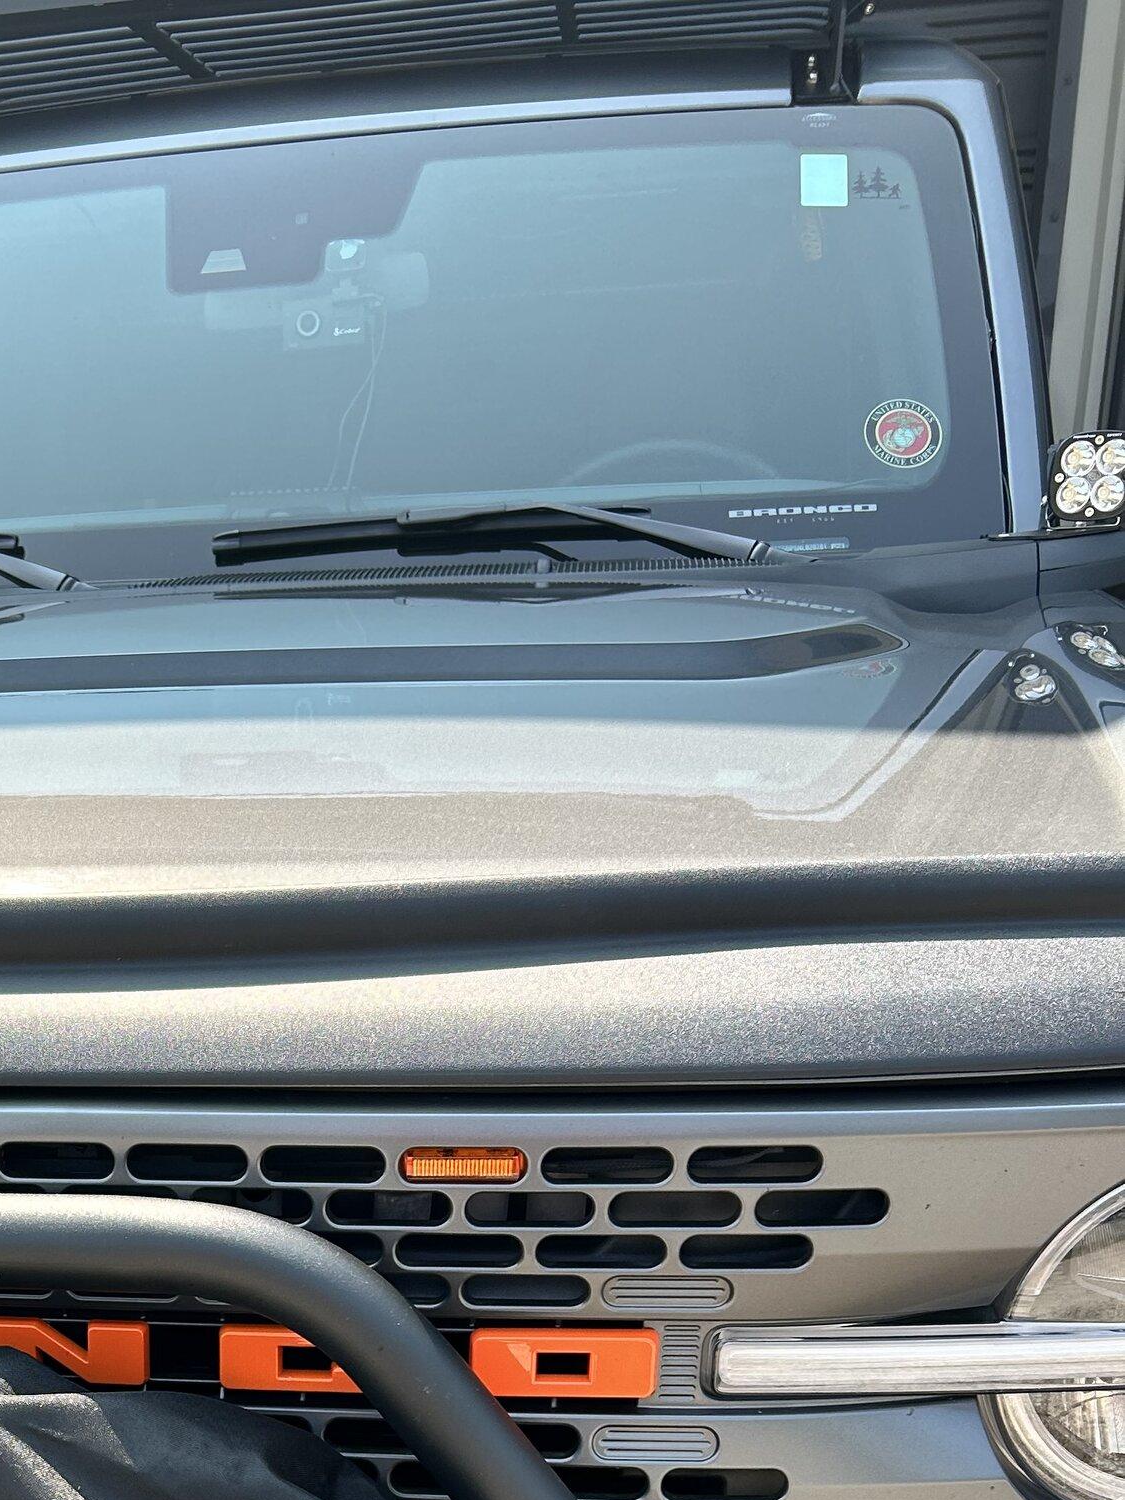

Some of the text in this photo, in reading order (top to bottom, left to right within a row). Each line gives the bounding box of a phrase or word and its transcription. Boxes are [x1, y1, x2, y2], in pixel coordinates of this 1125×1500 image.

[871, 401, 903, 422] UNITED
[904, 401, 935, 423] STATES
[874, 444, 936, 466] MARINE CORPS
[728, 504, 877, 518] BRONCO
